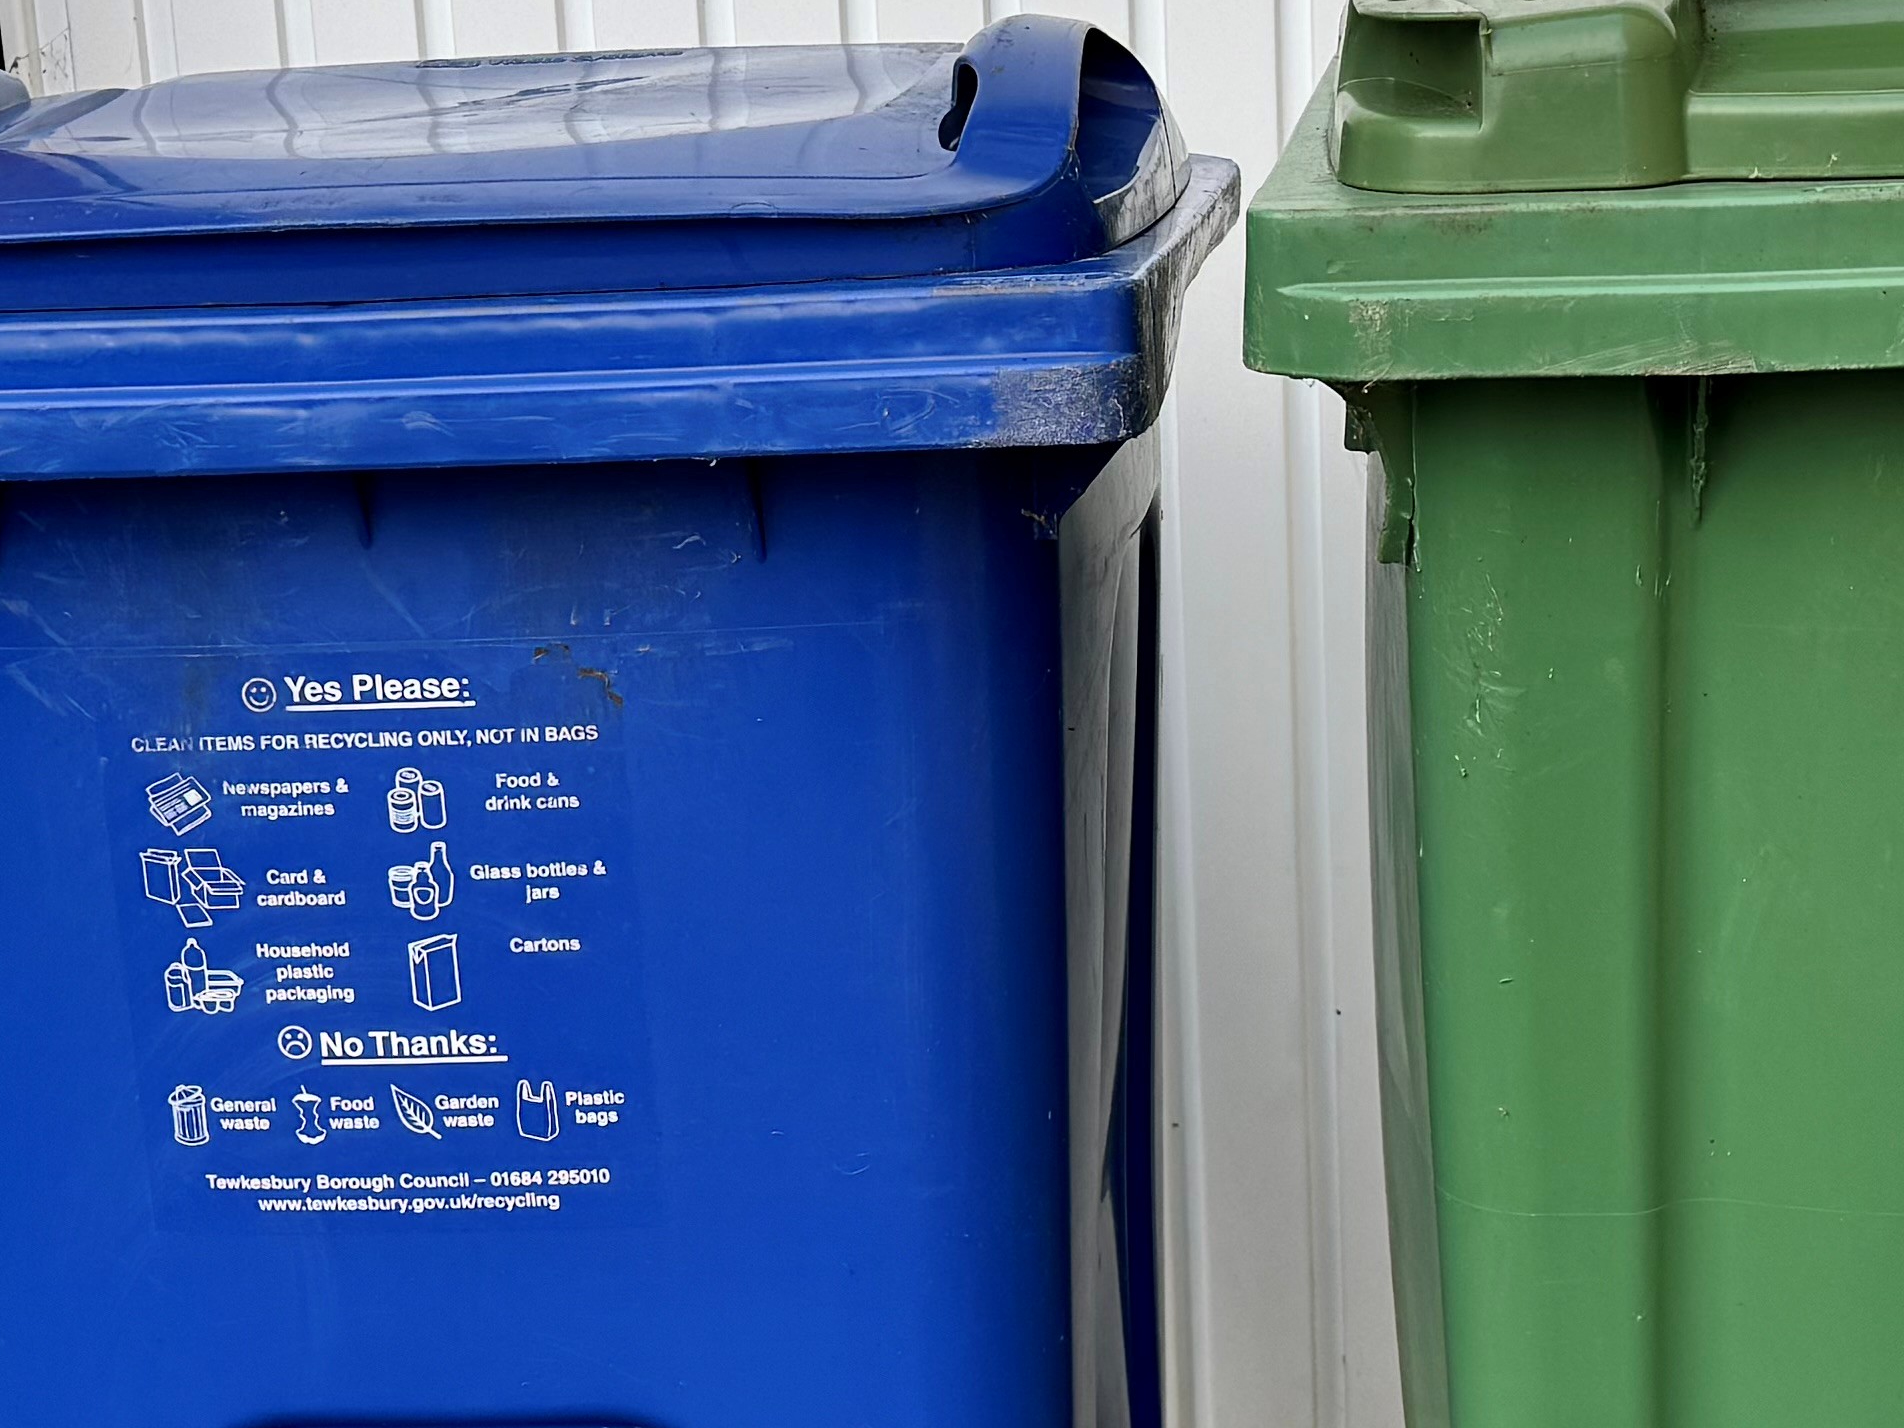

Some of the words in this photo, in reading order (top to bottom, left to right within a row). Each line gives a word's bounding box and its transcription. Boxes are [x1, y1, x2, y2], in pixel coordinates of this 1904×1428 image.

[284, 676, 342, 702] Yes
[353, 674, 470, 702] Please:
[132, 737, 192, 752] CLEAN
[199, 736, 255, 751] ITEMS
[261, 735, 299, 750] FOR
[305, 731, 412, 749] RECYCLING
[418, 730, 471, 747] ONLY,
[476, 728, 515, 744] NOT
[521, 727, 539, 742] IN
[545, 725, 598, 741] BAGS
[223, 781, 330, 797] Newspapers
[336, 778, 348, 793] &
[496, 772, 541, 788] Food
[547, 773, 559, 786] &
[241, 801, 334, 820] magazines
[486, 795, 531, 810] drink
[536, 796, 579, 809] cans
[267, 870, 308, 884] Card
[313, 869, 326, 883] &
[470, 865, 521, 879] Glass
[526, 862, 588, 877] bottles
[593, 861, 606, 875] &
[257, 891, 345, 906] cardboard
[526, 885, 559, 903] jars
[256, 942, 349, 958] Household
[510, 938, 580, 952] Cartons
[277, 964, 334, 982] plastic
[266, 985, 354, 1004] packaging
[320, 1032, 363, 1057] No
[368, 1030, 497, 1057] Thanks:
[210, 1098, 276, 1112] General
[330, 1097, 374, 1111] Food
[435, 1095, 499, 1110] Garden
[566, 1090, 624, 1106] Plastic
[220, 1117, 270, 1130] waste
[329, 1116, 379, 1129] waste
[443, 1113, 494, 1127] waste
[576, 1110, 618, 1126] bags
[206, 1175, 311, 1193] Tewkesbury
[317, 1174, 394, 1192] Borough
[400, 1173, 469, 1188] Council
[490, 1171, 542, 1186] 01684
[548, 1168, 610, 1184] 295010
[258, 1193, 560, 1213] www.tewkesbury.gov.uk/recycling
